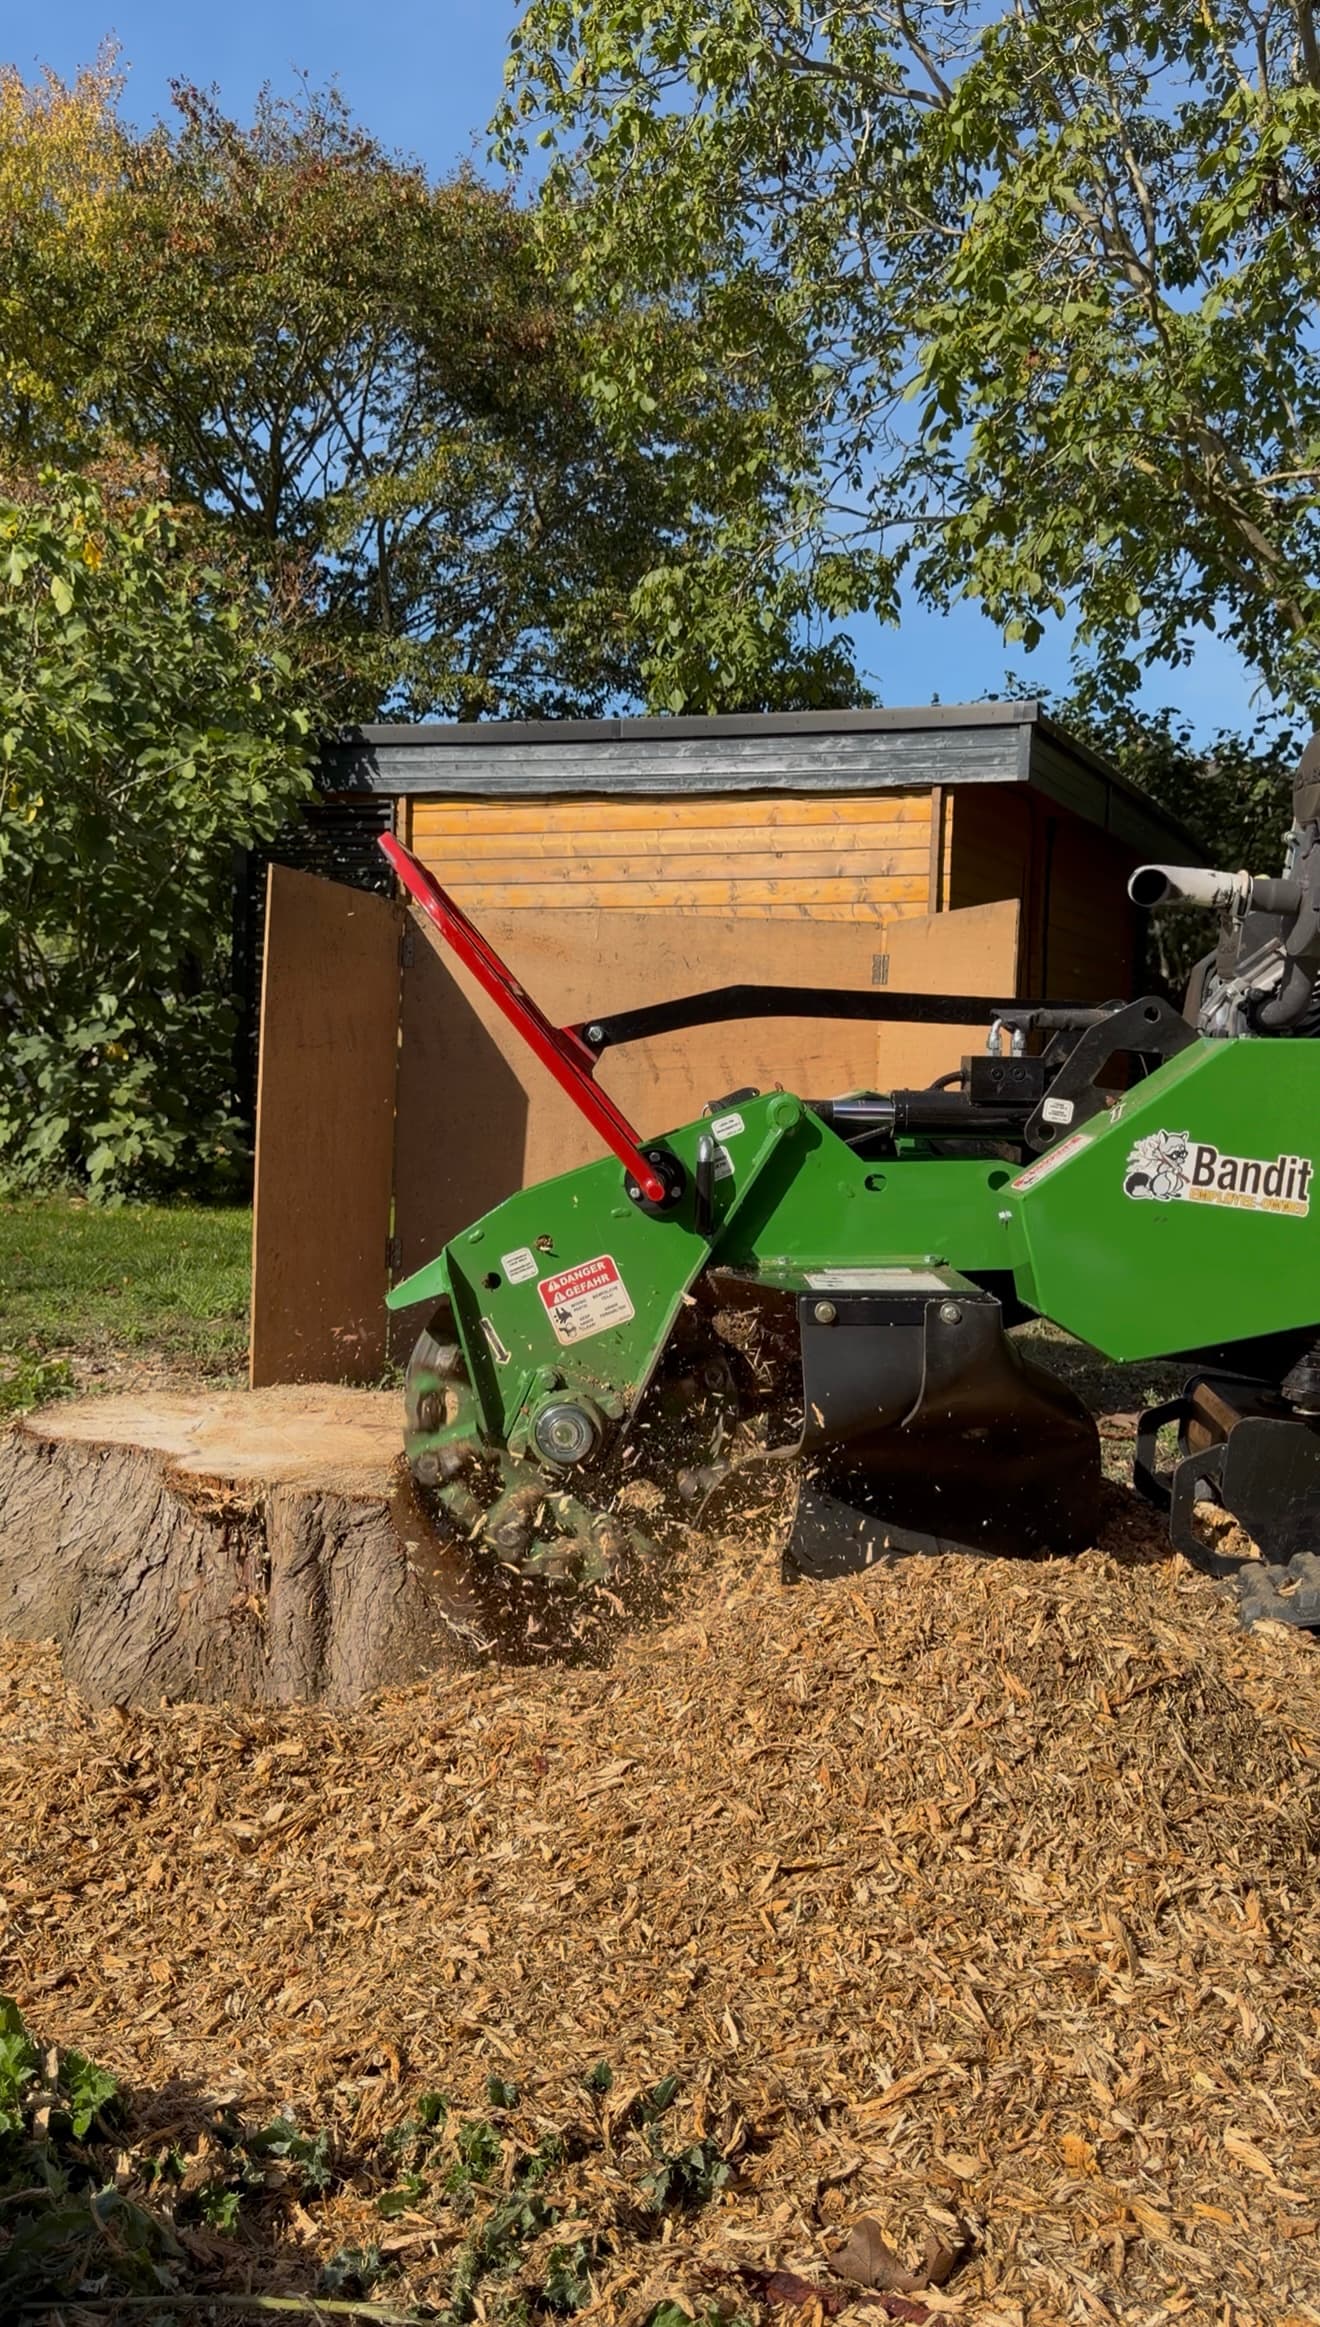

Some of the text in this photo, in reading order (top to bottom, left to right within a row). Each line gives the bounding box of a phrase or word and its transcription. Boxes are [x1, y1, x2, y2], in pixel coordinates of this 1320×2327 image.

[1192, 1146, 1311, 1200] Bandit
[560, 1262, 606, 1285] DANGER
[565, 1273, 610, 1297] GEFAHR
